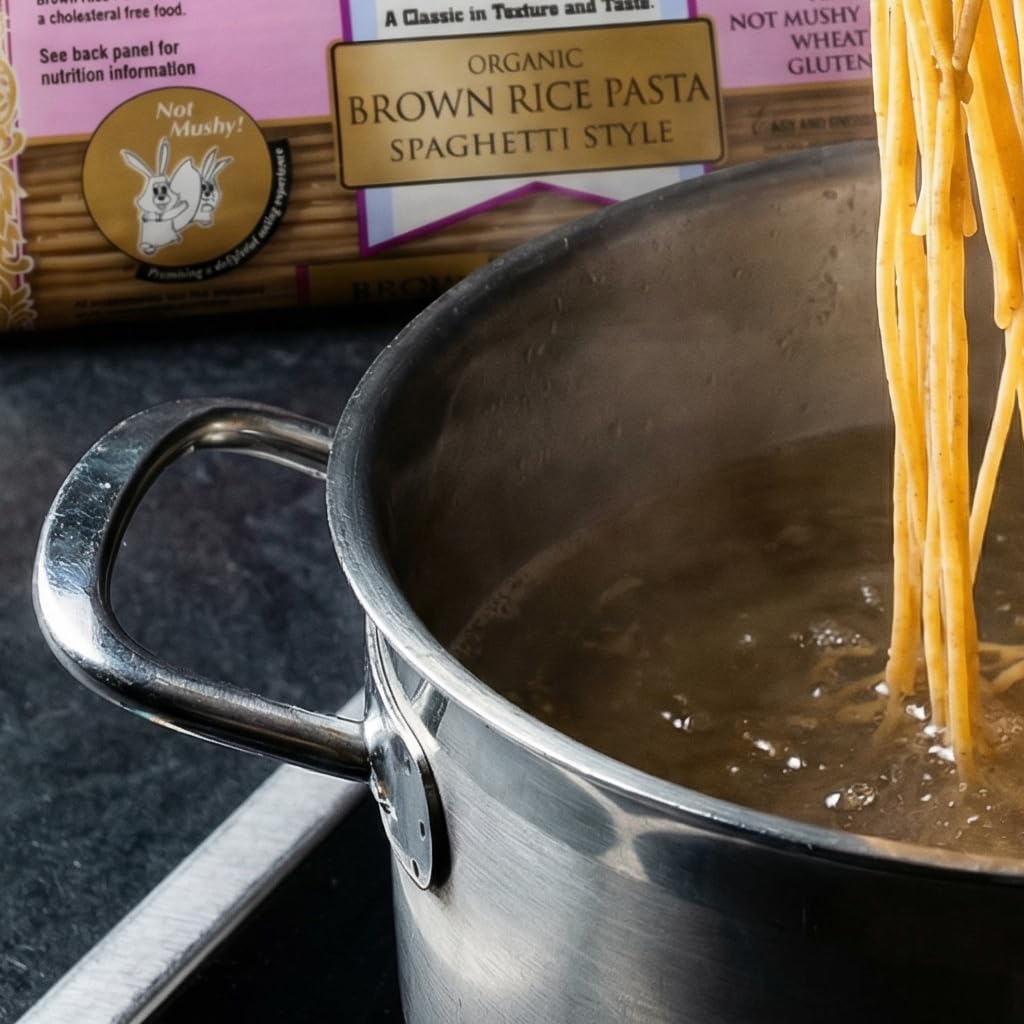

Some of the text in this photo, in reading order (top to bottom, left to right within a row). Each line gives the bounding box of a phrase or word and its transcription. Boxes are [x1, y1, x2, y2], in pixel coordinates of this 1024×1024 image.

[38, 15, 45, 25] a
[124, 6, 150, 19] free
[154, 1, 186, 17] food.
[385, 10, 398, 27] A
[469, 6, 487, 22] in
[730, 5, 860, 31] NOT MUSHY
[791, 29, 868, 49] WHEAT
[39, 40, 179, 64] See back panel for
[467, 48, 584, 75] ORGANIC
[41, 60, 196, 86] nutrition information
[156, 101, 194, 121] Not
[349, 73, 711, 126] BROWN RICE PASTA
[170, 116, 244, 139] Mushy!
[390, 120, 674, 162] SPAGHETTI STYLE
